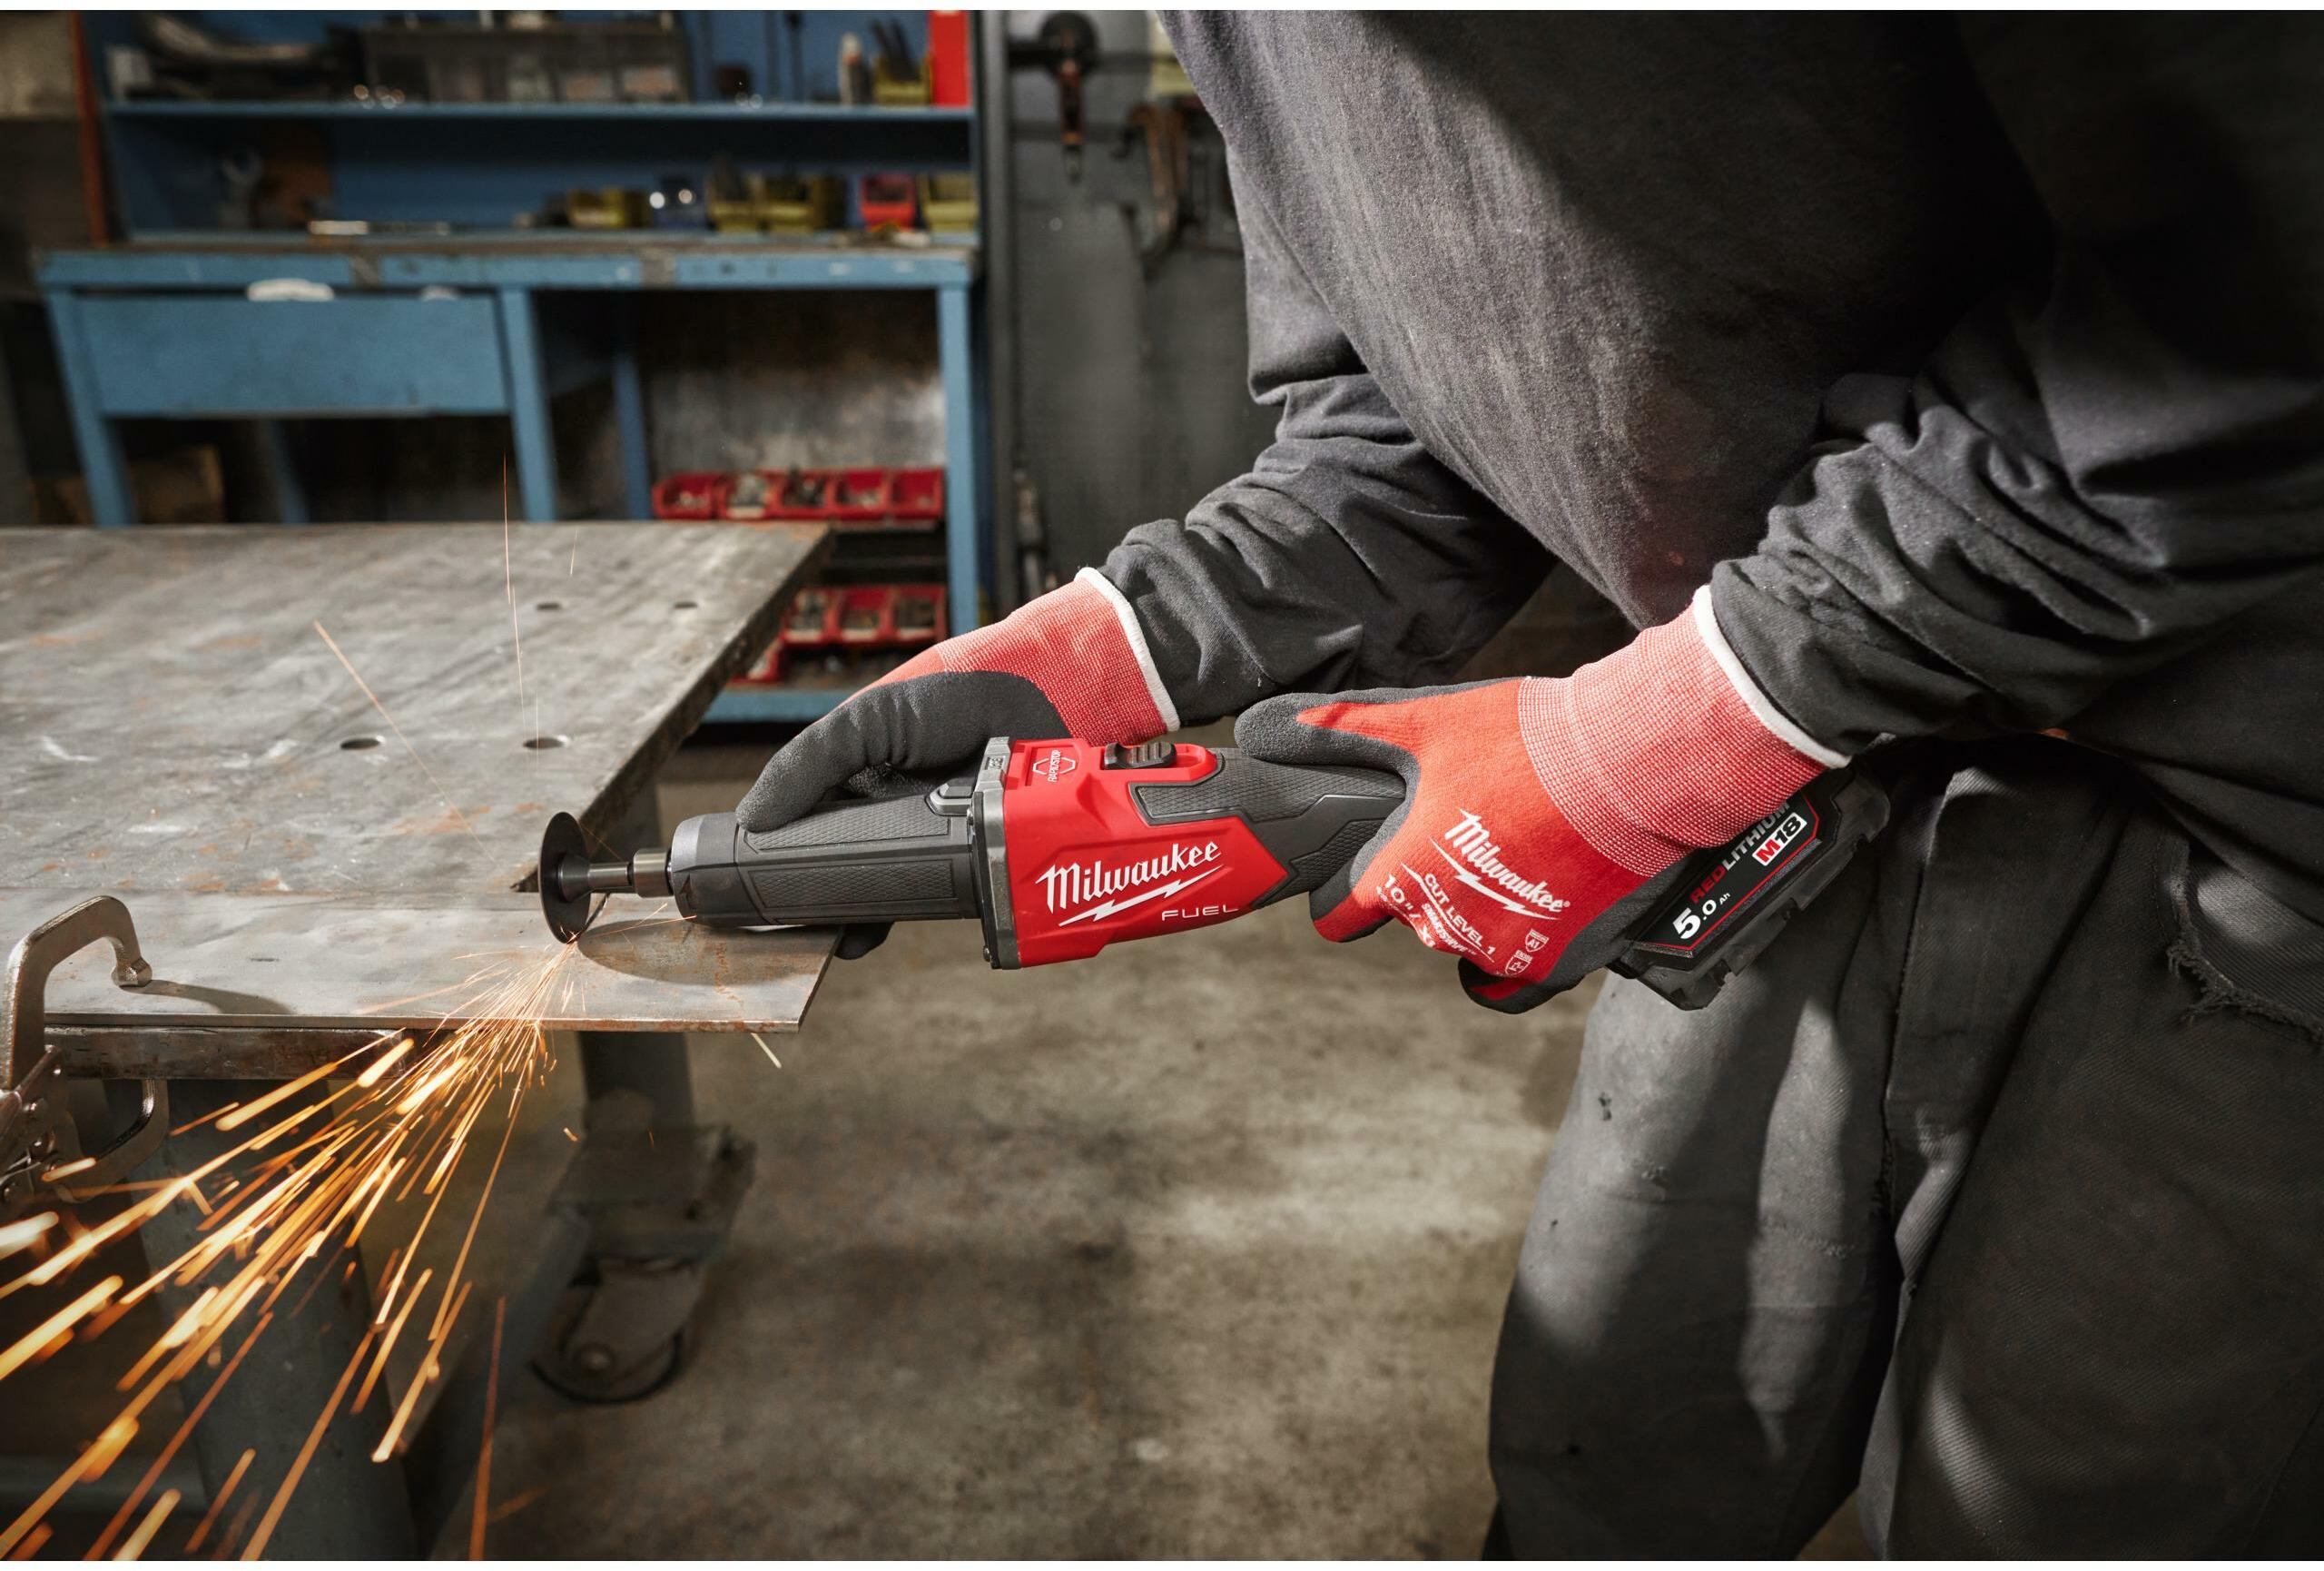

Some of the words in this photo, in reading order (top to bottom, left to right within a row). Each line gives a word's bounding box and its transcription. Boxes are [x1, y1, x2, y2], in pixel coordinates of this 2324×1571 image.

[1047, 749, 1061, 783] RAPIDSTOP
[1756, 815, 1803, 864] M18
[1035, 842, 1221, 914] Milwaukee
[1161, 904, 1239, 922] FUEL
[1425, 874, 1450, 904] CUT
[1446, 906, 1483, 946] LEVEL
[1487, 945, 1496, 955] 1
[1673, 899, 1717, 939] 5.0
[1719, 893, 1730, 905] Ah
[1527, 939, 1540, 950] A1
